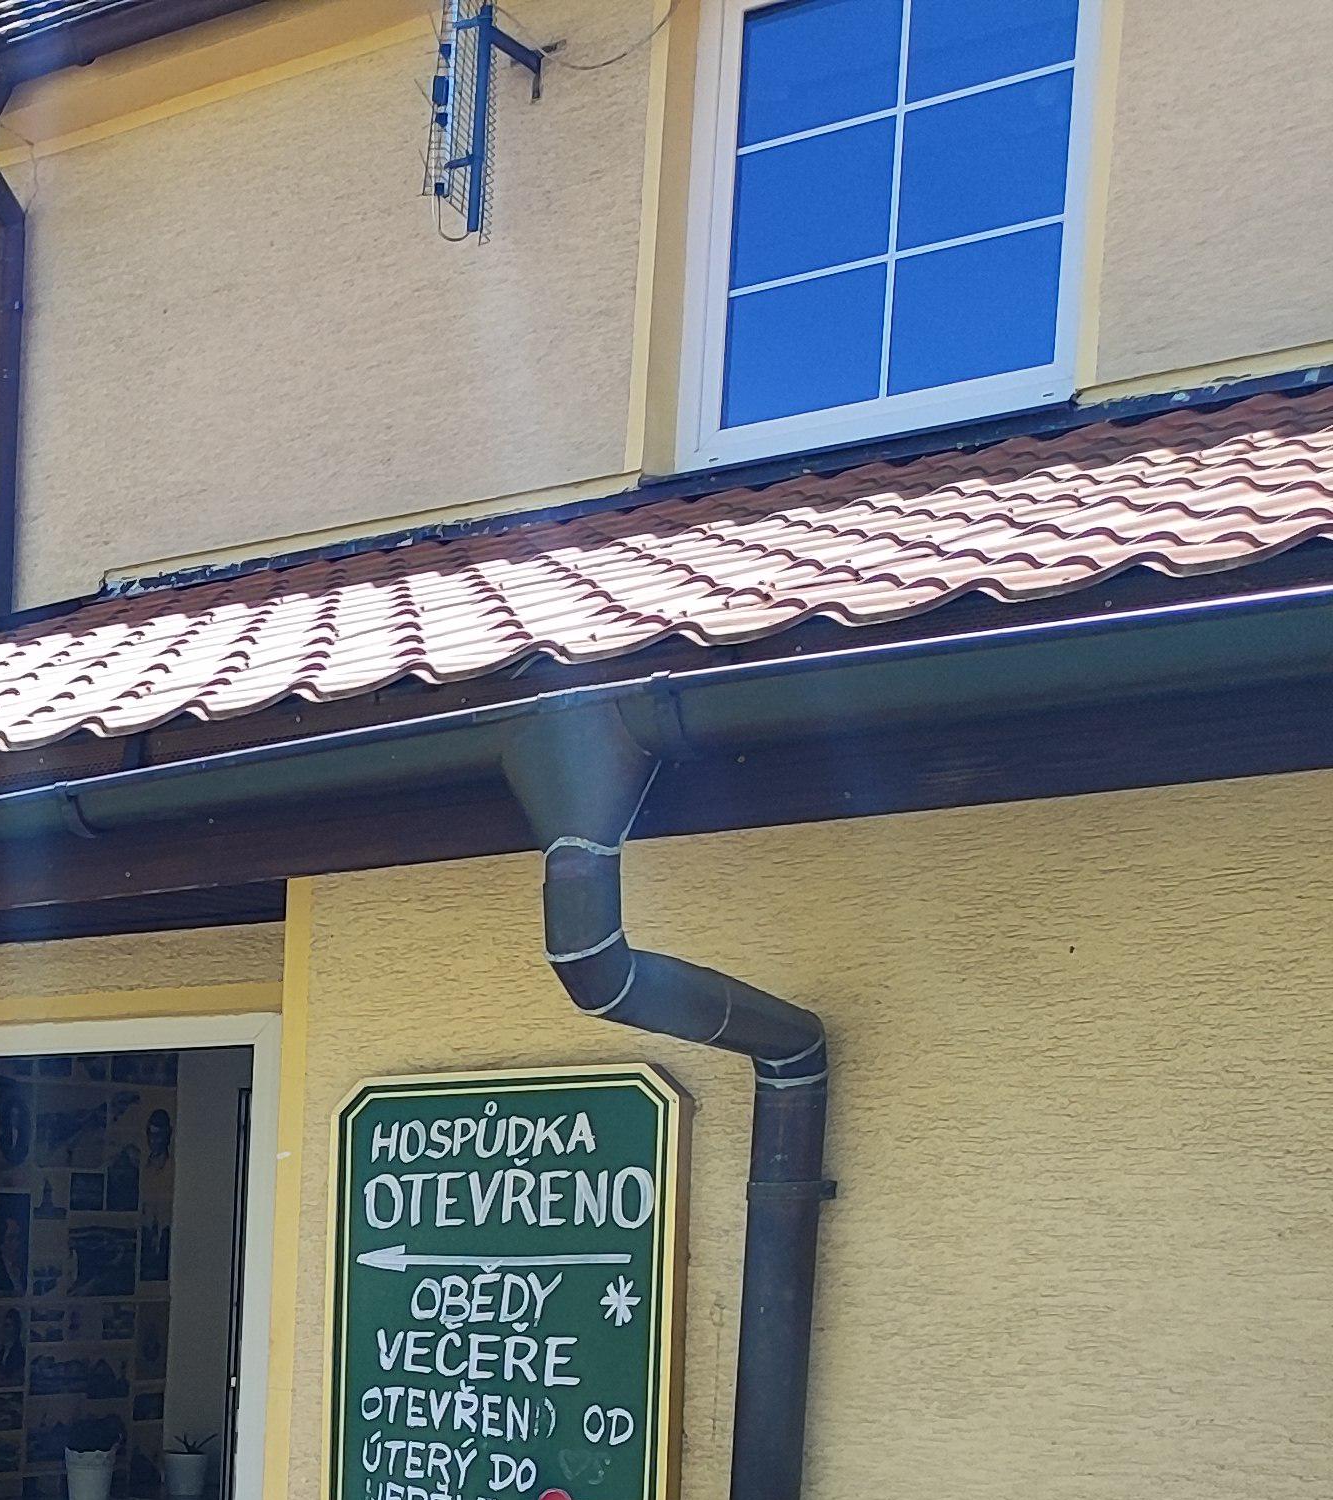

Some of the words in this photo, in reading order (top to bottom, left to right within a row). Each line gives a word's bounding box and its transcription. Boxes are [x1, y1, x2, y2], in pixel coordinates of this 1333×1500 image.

[371, 1101, 597, 1164] HOSPŮDKA
[363, 1157, 655, 1230] OTEVŘENO
[410, 1260, 564, 1328] OBĚDY
[376, 1321, 581, 1388] VEČEŘE
[583, 1404, 635, 1446] OD
[362, 1430, 478, 1490] ÚTERÝ
[488, 1453, 537, 1493] DO
